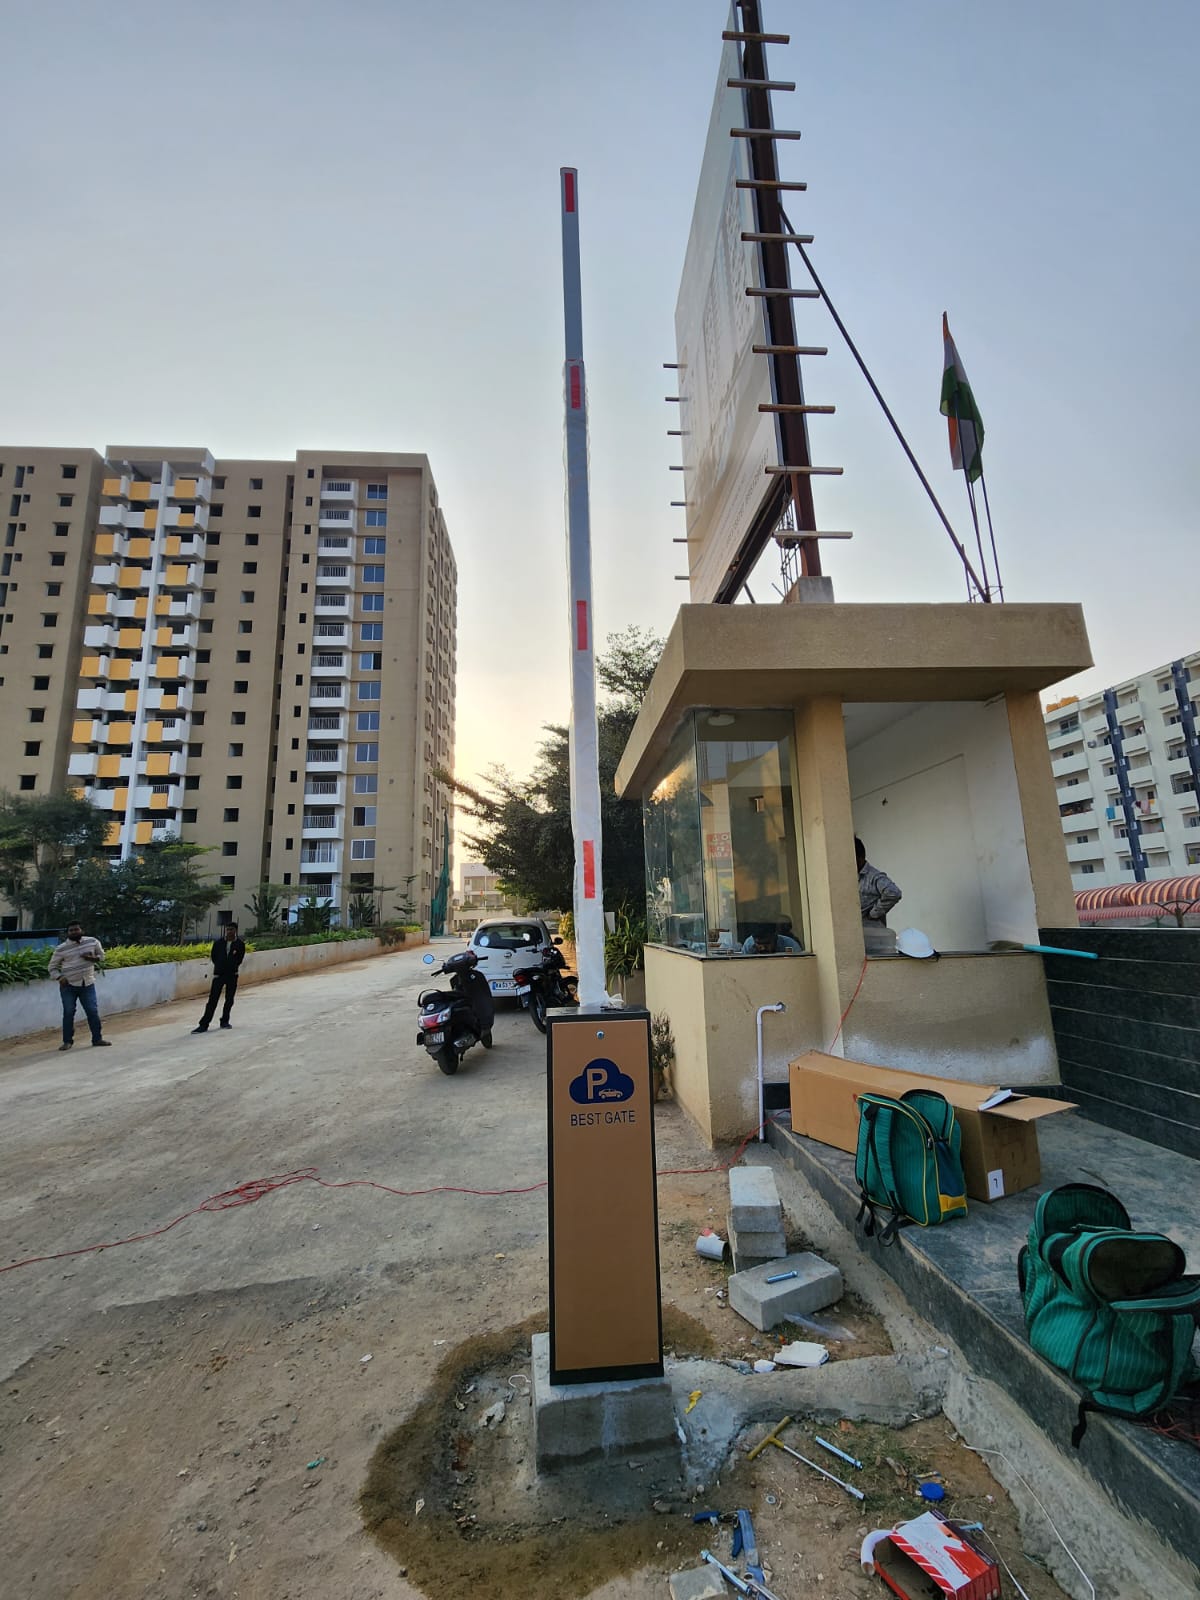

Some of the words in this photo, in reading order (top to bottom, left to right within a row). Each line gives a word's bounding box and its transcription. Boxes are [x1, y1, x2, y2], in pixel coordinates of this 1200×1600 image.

[586, 1068, 608, 1100] P
[570, 1112, 602, 1127] BEST
[604, 1109, 636, 1124] GATE
